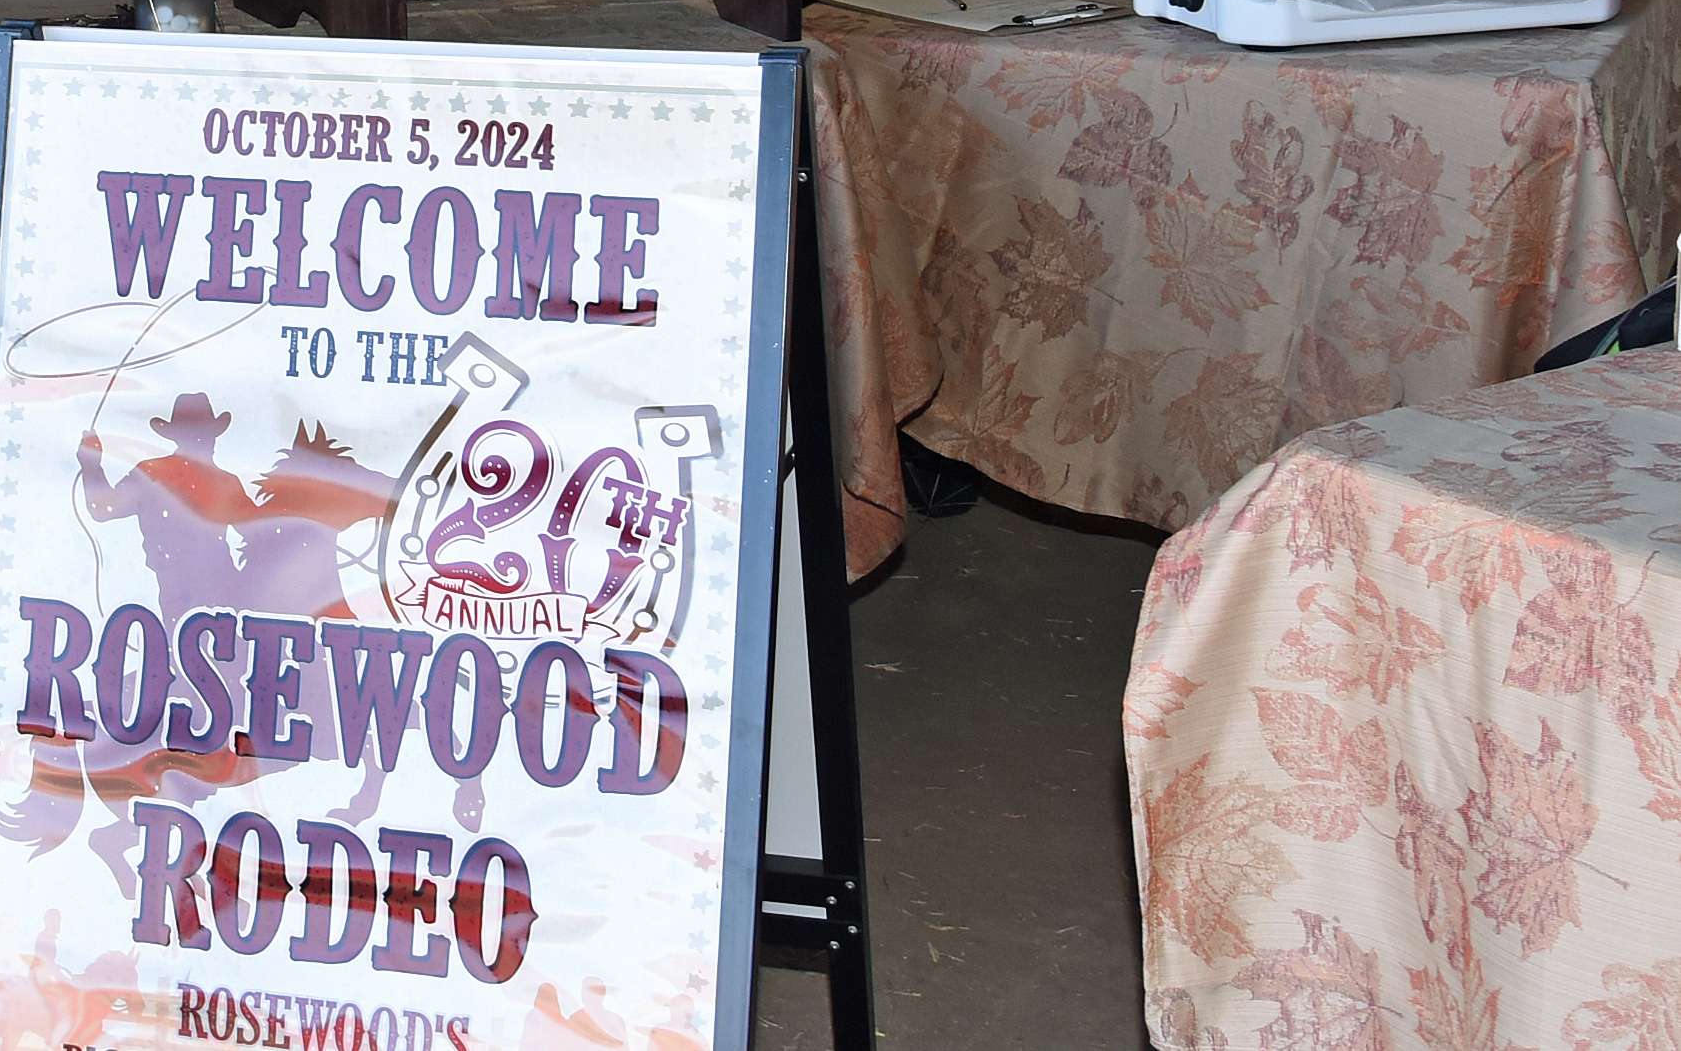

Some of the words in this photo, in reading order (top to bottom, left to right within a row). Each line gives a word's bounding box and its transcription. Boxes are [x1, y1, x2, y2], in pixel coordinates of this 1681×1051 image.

[203, 107, 392, 165] OCTOBER
[408, 122, 439, 171] 5,
[457, 119, 556, 171] 2024
[96, 171, 660, 326] WELCOME
[281, 325, 338, 380] TO
[357, 330, 450, 386] THE
[435, 593, 574, 636] ANNUAL
[16, 595, 690, 796] ROSEWOOD
[131, 800, 538, 986] RODEO
[176, 982, 470, 1051] ROSEWOOD'S
